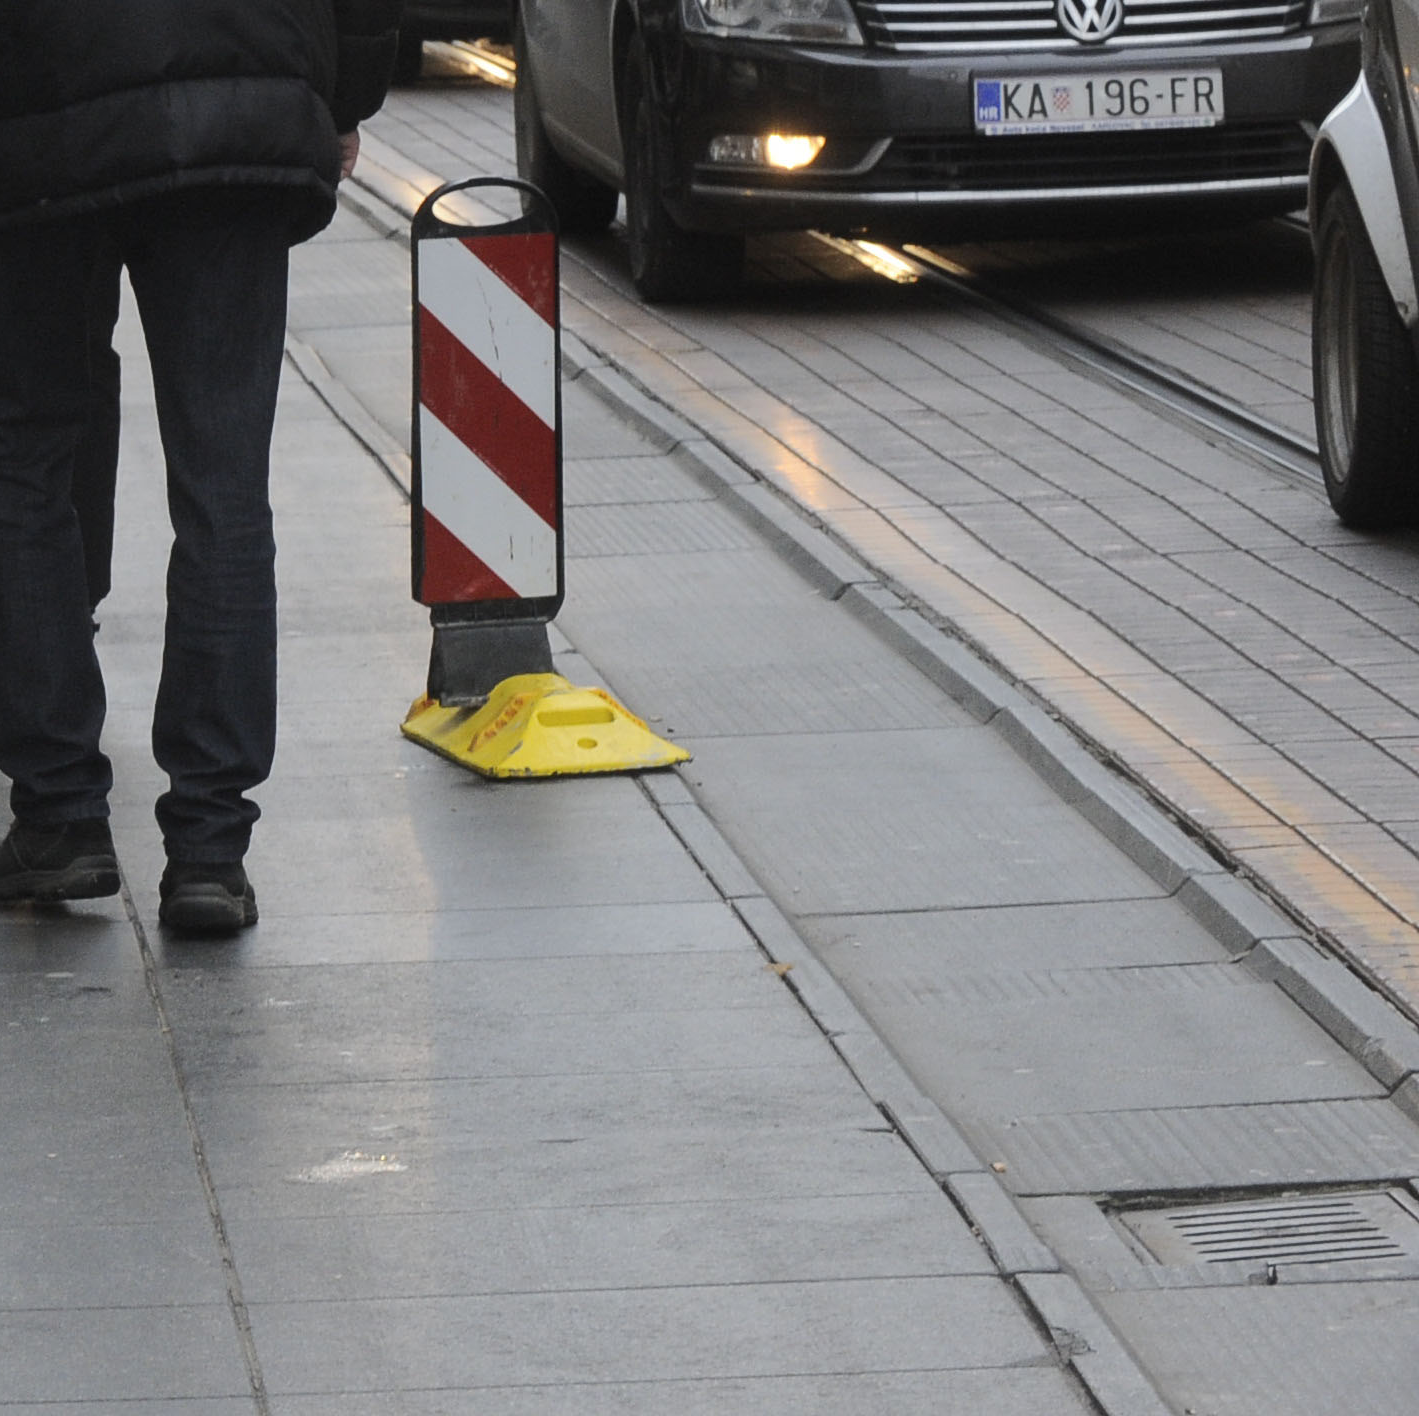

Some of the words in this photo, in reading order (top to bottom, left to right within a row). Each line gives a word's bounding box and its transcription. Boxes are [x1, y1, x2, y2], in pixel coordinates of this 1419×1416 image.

[979, 105, 999, 119] HR
[1004, 83, 1048, 120] KA
[1085, 76, 1215, 117] 196-FR
